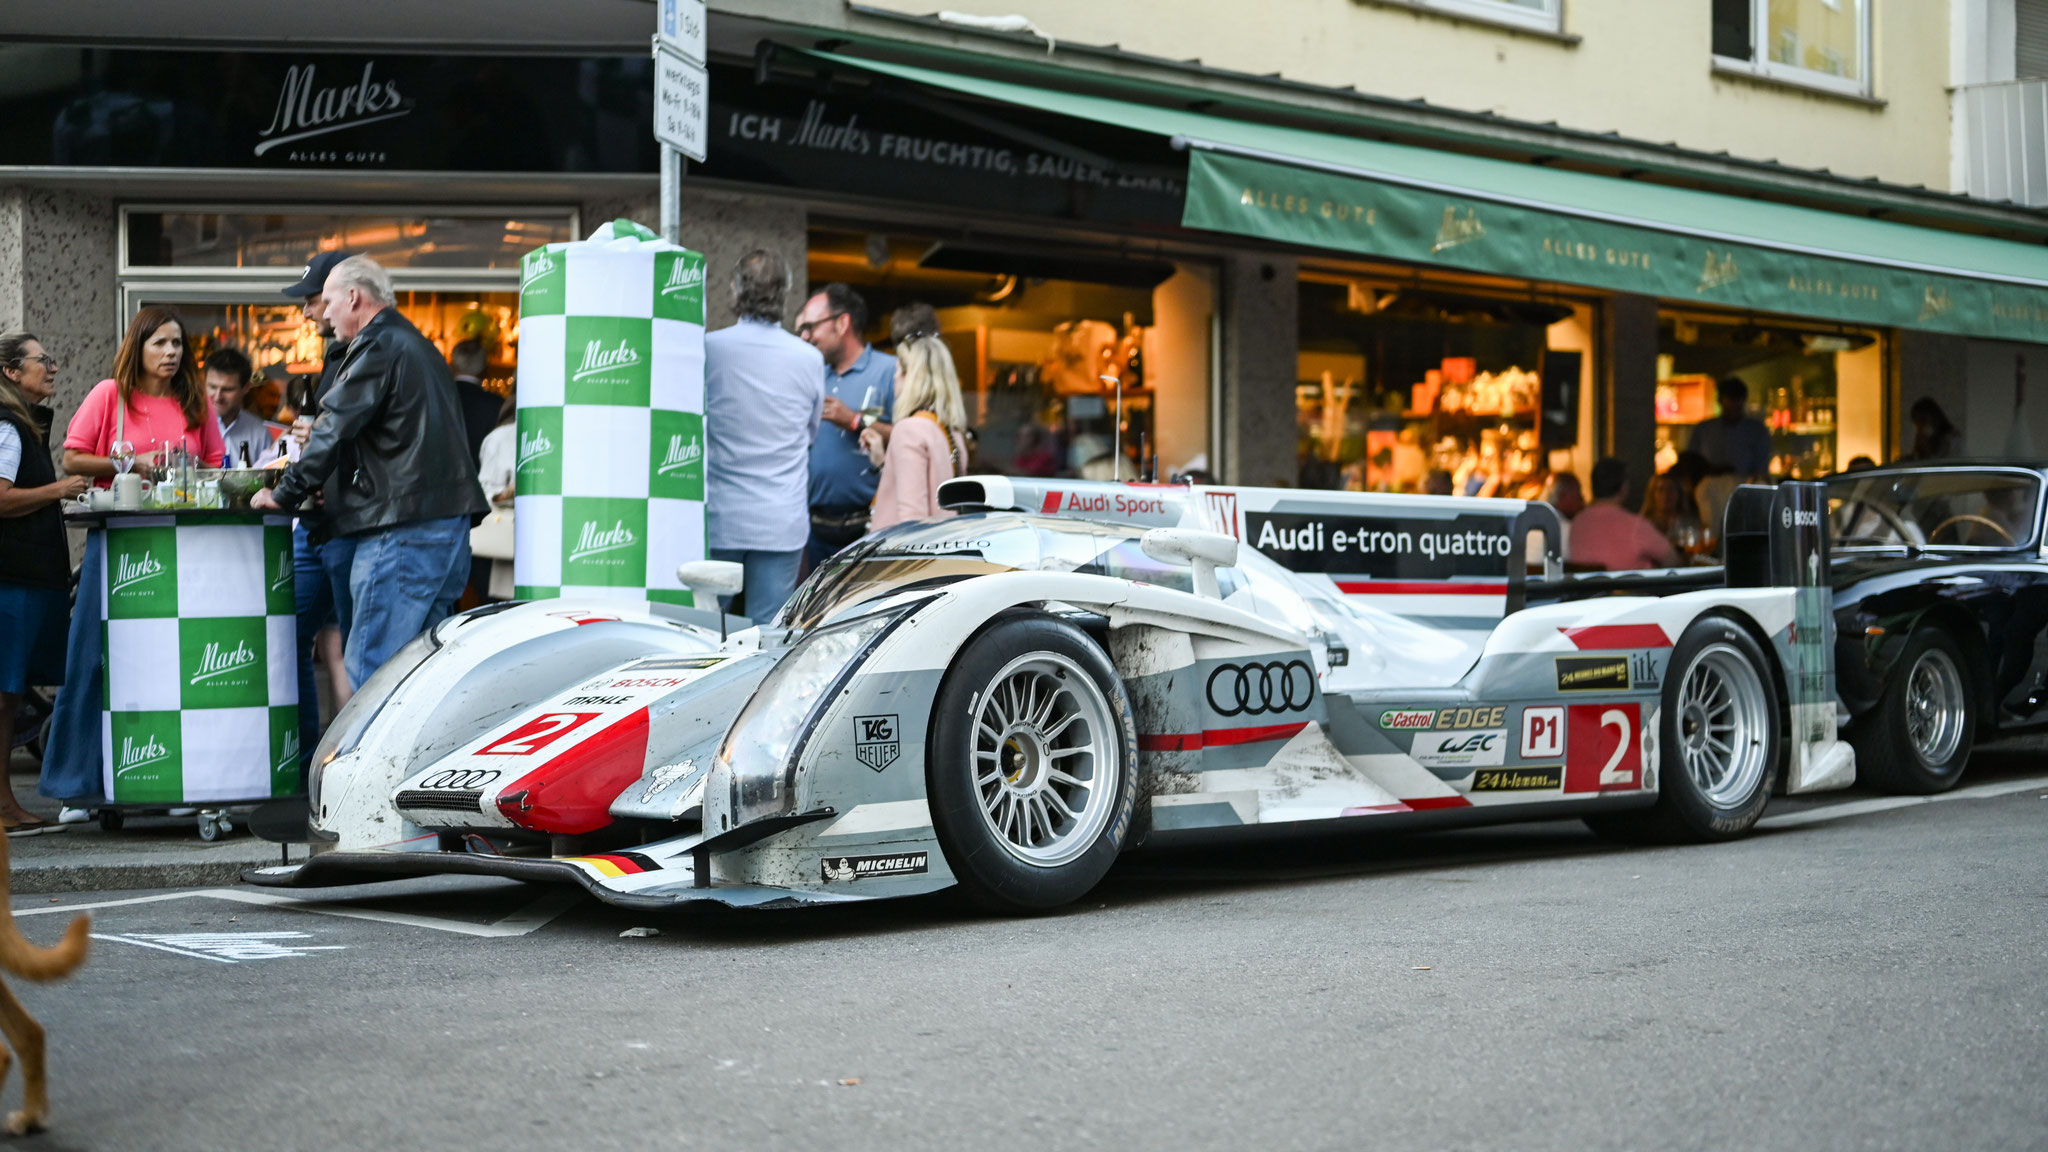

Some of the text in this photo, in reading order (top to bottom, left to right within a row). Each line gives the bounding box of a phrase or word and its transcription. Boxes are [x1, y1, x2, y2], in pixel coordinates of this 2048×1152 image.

[256, 60, 402, 140] Marks
[728, 112, 781, 143] ICH
[787, 99, 872, 155] Marks
[879, 133, 1018, 176] FRUCHTIG,
[289, 151, 387, 162] ALLES GUTE
[1241, 187, 1376, 226] ALLES GUTE
[1543, 237, 1650, 270] ALLES GUTE
[574, 339, 639, 375] Marks
[517, 428, 552, 465] Marks
[1068, 492, 1165, 517] Audi Sport
[1794, 510, 1818, 526] BOSCH
[571, 520, 635, 555] Marks
[1258, 520, 1512, 561] Audi e-tron quattro
[113, 551, 162, 587] Marks
[192, 640, 255, 677] Marks
[1632, 650, 1658, 681] itk
[610, 677, 687, 688] BOSCH
[562, 695, 635, 706] MAHLE
[1392, 706, 1506, 729] Castrol EDGE
[486, 714, 578, 754] 2
[861, 718, 892, 741] TAG
[1437, 733, 1499, 753] WEC
[1529, 716, 1557, 750] P1
[117, 734, 167, 770] Marks
[859, 744, 897, 768] HEUER
[1599, 709, 1634, 785] 2
[1115, 717, 1138, 846] MICHELIN
[855, 855, 927, 871] MICHELIN
